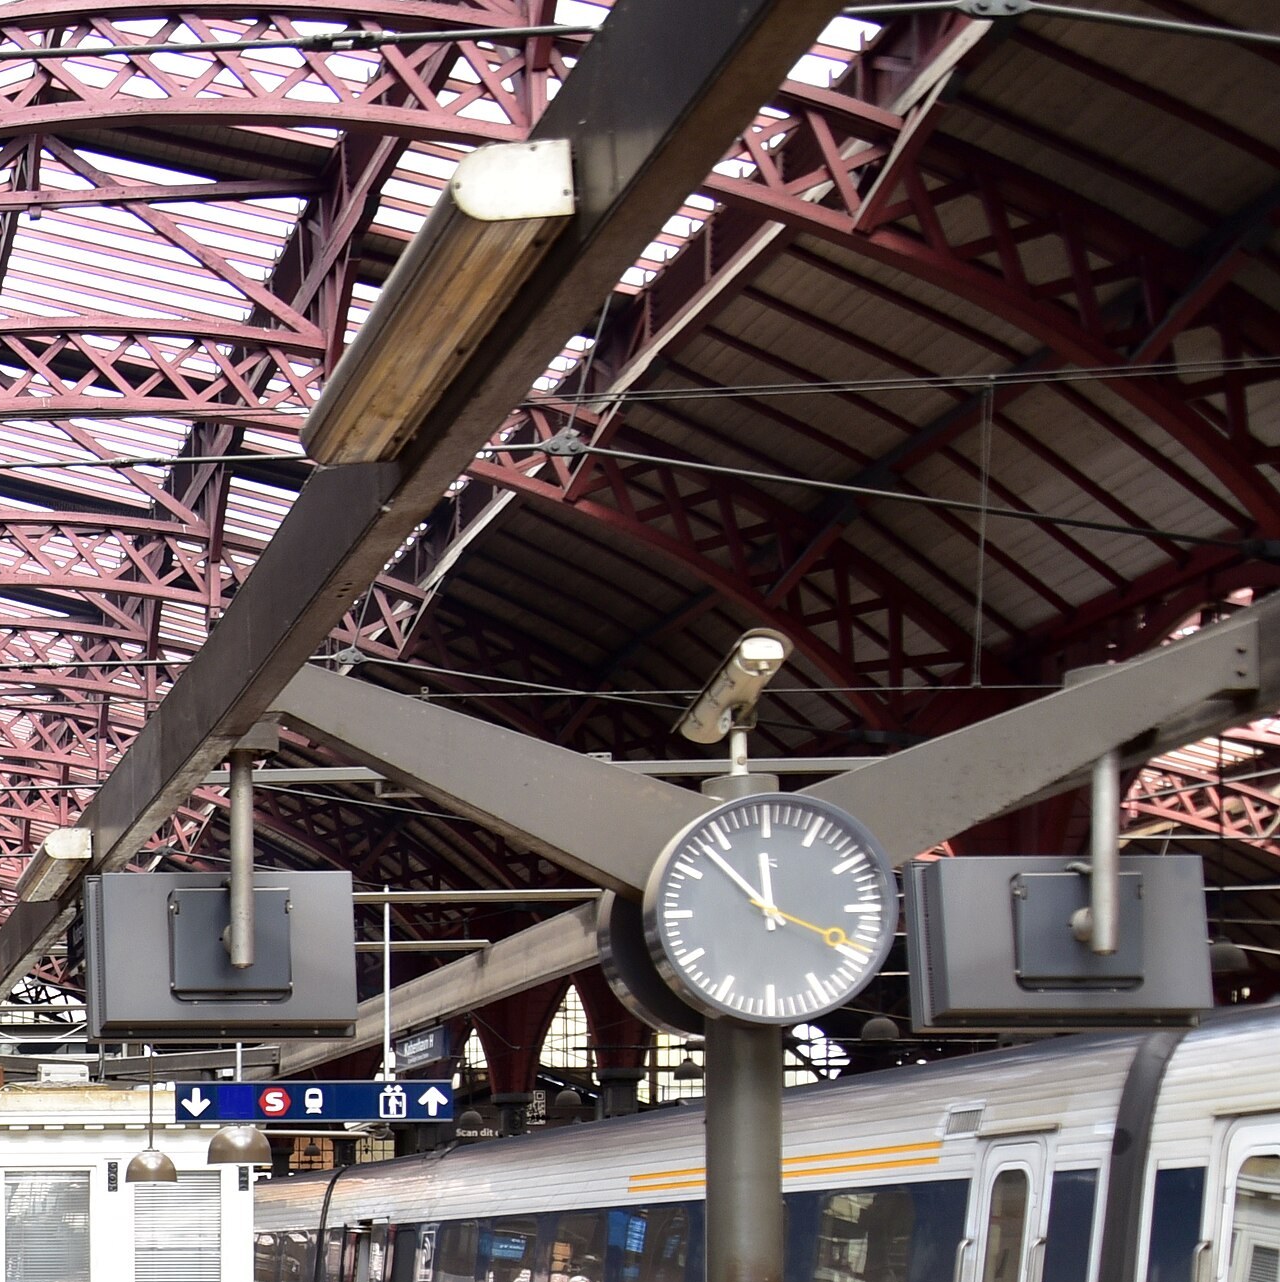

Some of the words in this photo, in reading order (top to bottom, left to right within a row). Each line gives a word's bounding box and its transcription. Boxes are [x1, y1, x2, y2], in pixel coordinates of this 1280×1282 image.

[429, 1033, 434, 1048] H
[265, 1091, 284, 1112] S
[455, 1128, 478, 1137] Scan
[479, 1127, 492, 1137] dit
